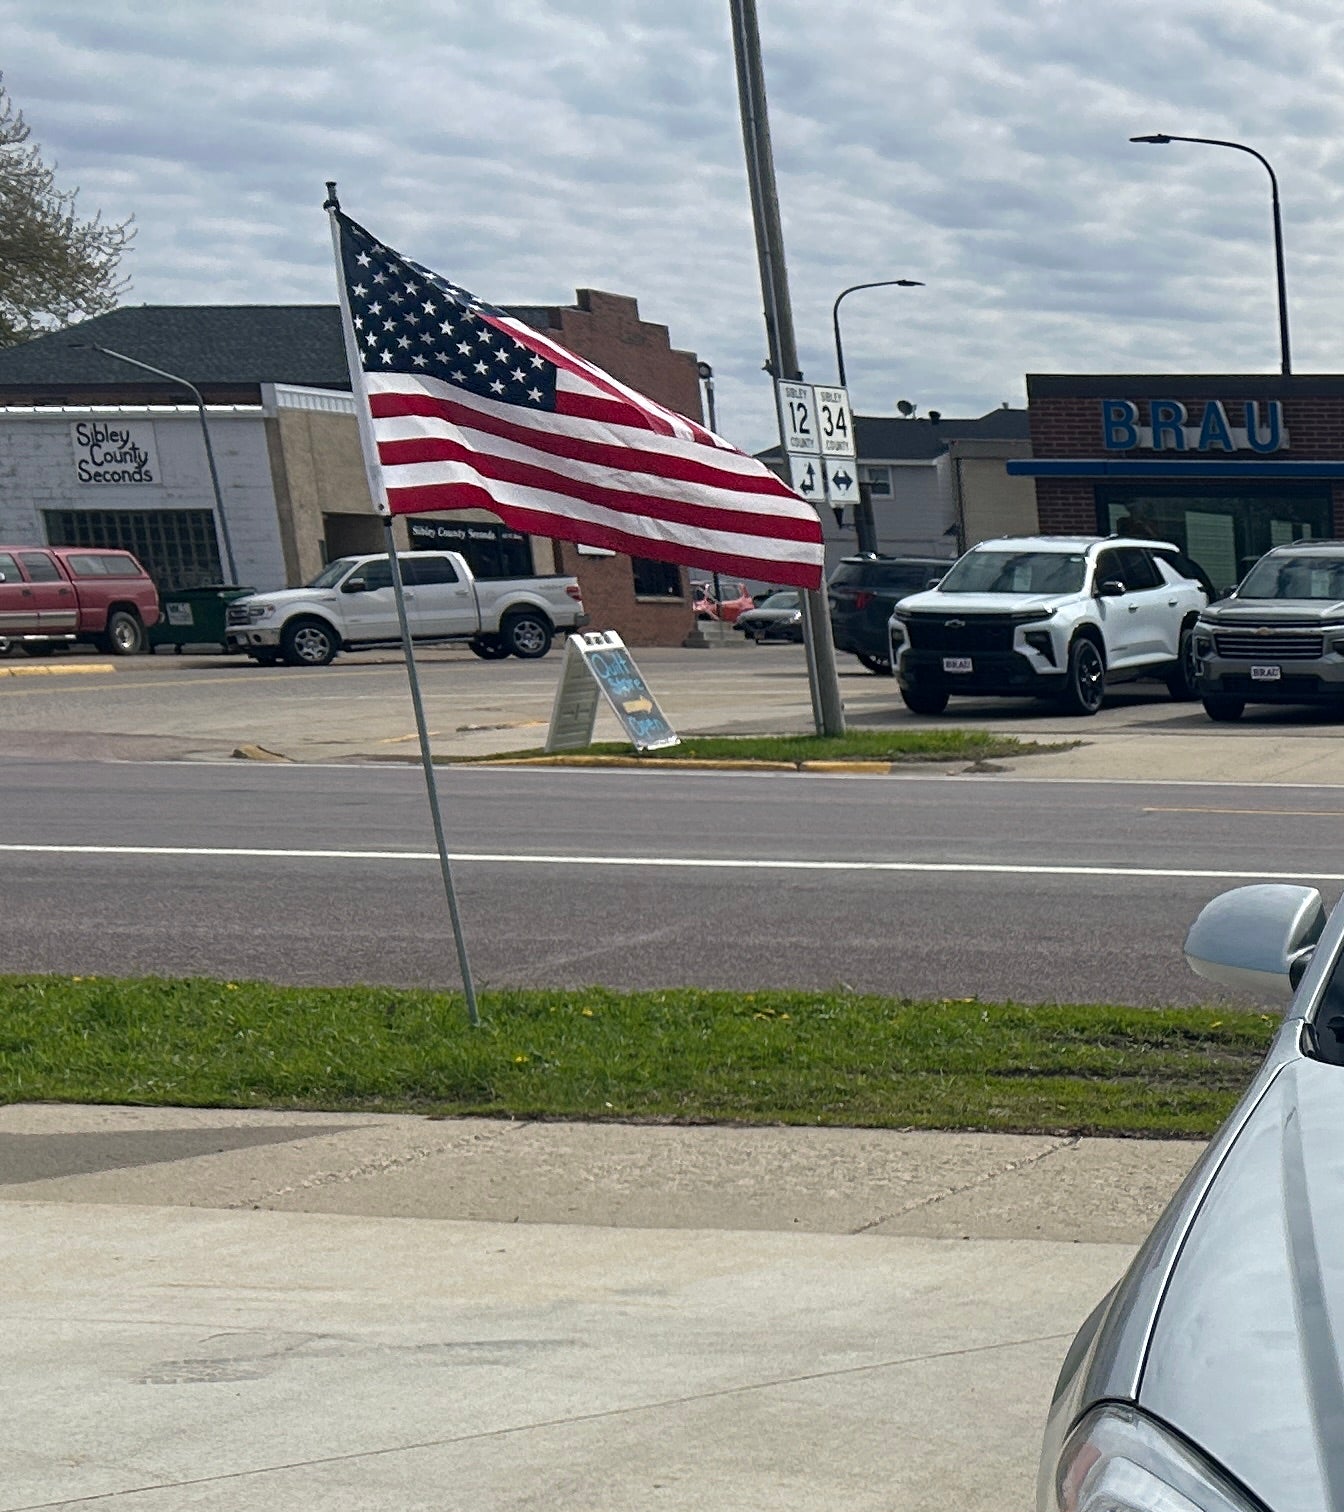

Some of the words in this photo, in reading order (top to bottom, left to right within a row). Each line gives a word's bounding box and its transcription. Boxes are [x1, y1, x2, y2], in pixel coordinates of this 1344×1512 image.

[789, 401, 810, 434] 12
[822, 404, 847, 438] 34
[1102, 399, 1287, 454] BRAU
[76, 422, 130, 450] Sibley
[90, 441, 148, 470] County
[77, 458, 153, 483] Seconds
[591, 650, 631, 679] Quilt
